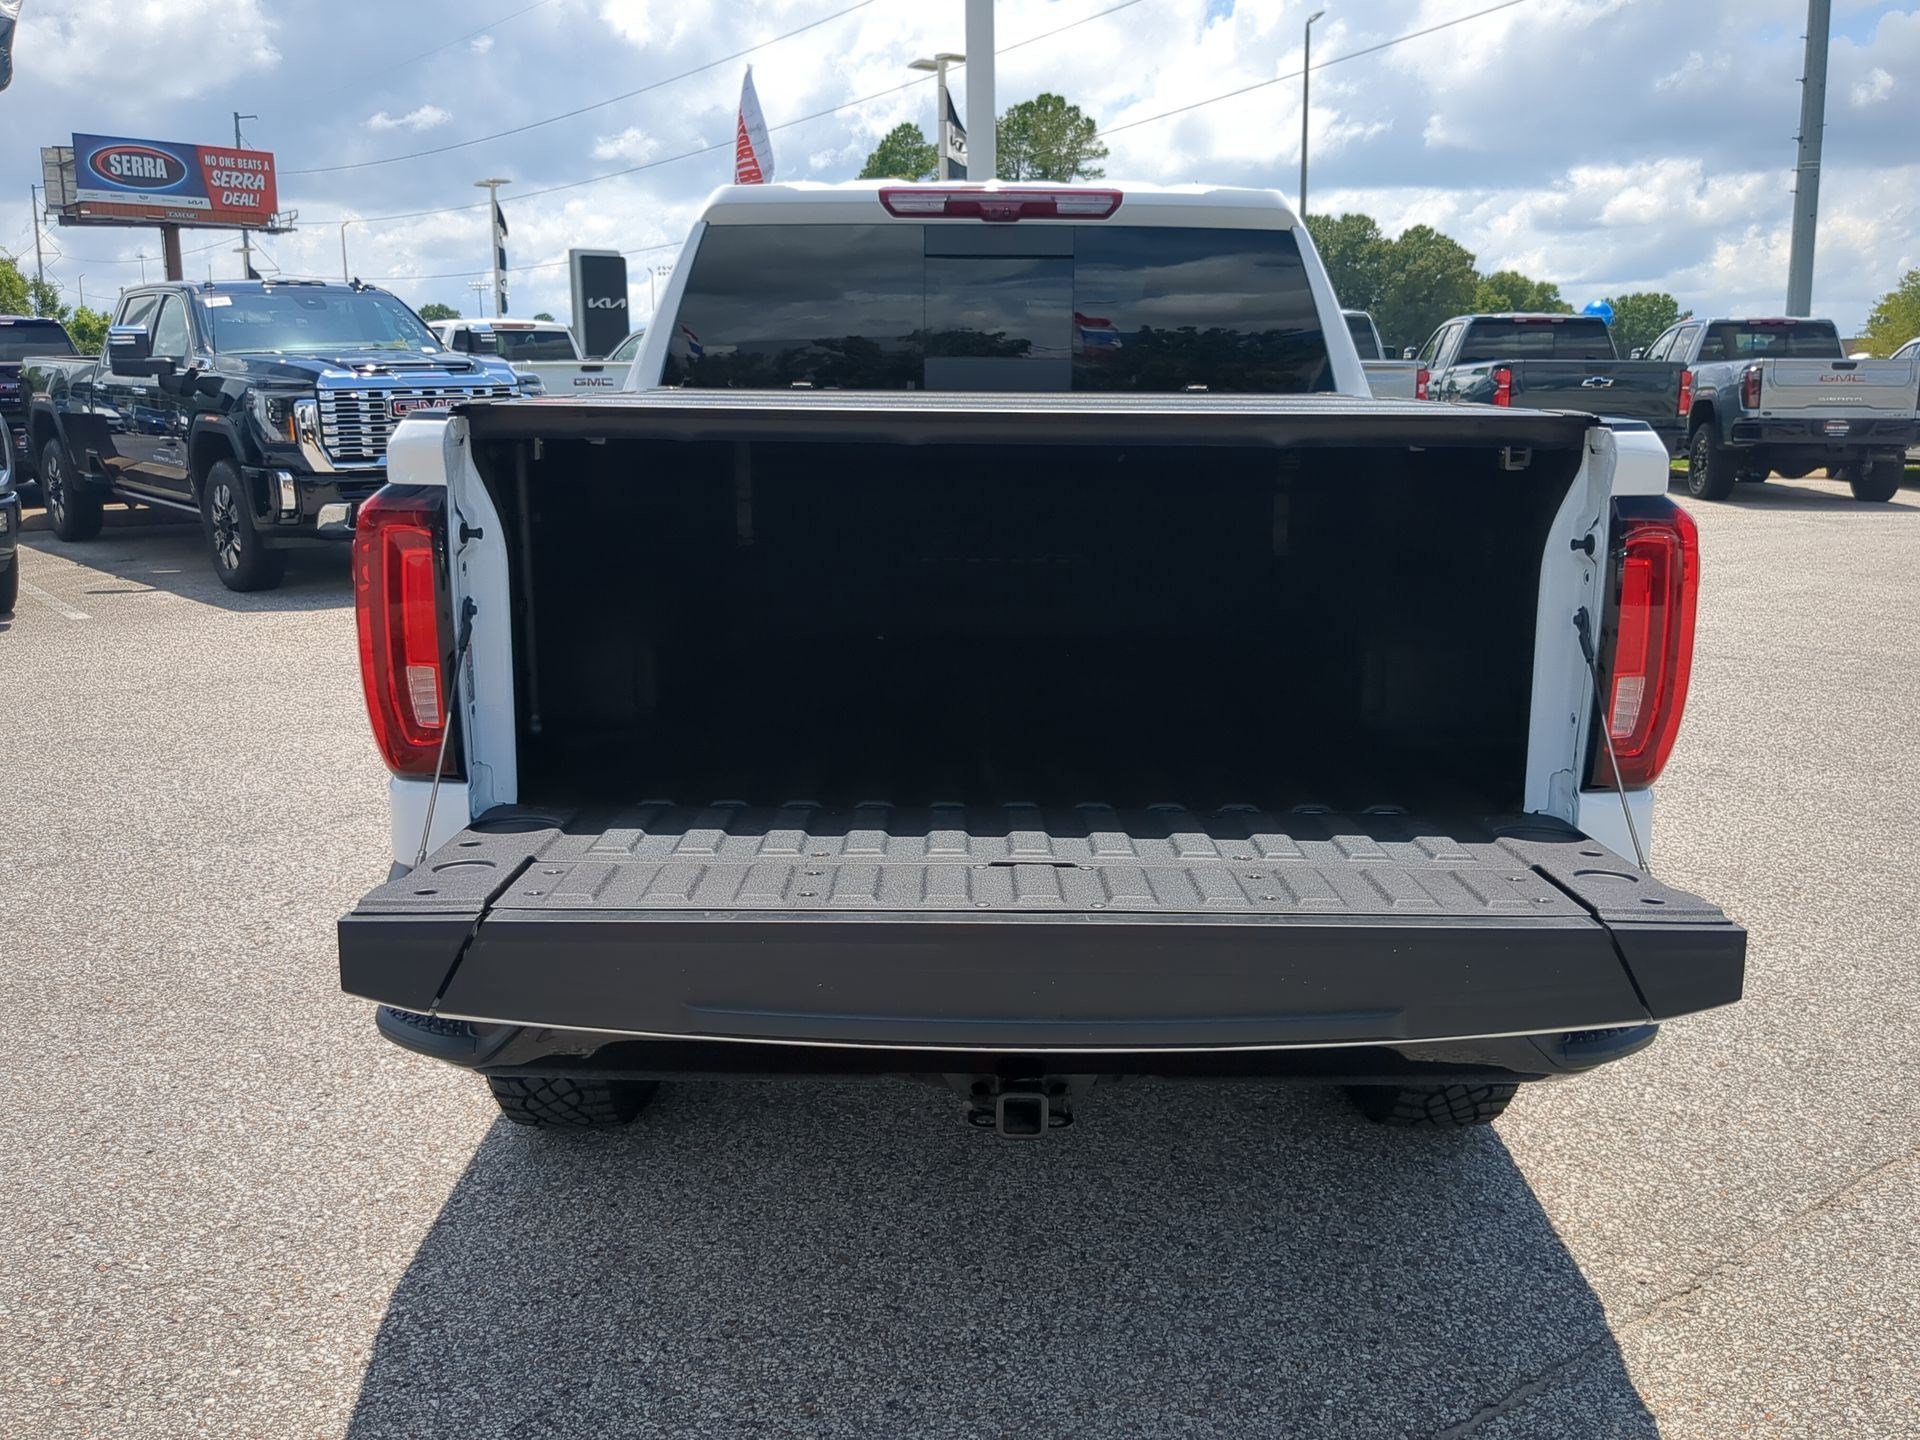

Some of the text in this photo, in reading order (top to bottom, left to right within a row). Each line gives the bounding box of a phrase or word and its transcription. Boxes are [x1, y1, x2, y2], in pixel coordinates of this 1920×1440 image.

[109, 154, 168, 179] SERRA
[204, 154, 270, 171] NO ONE BEATS A
[211, 169, 265, 191] SERRA
[222, 191, 260, 207] DEAL!
[587, 297, 627, 310] KIA
[573, 378, 614, 387] GMC
[1818, 374, 1865, 383] GMC
